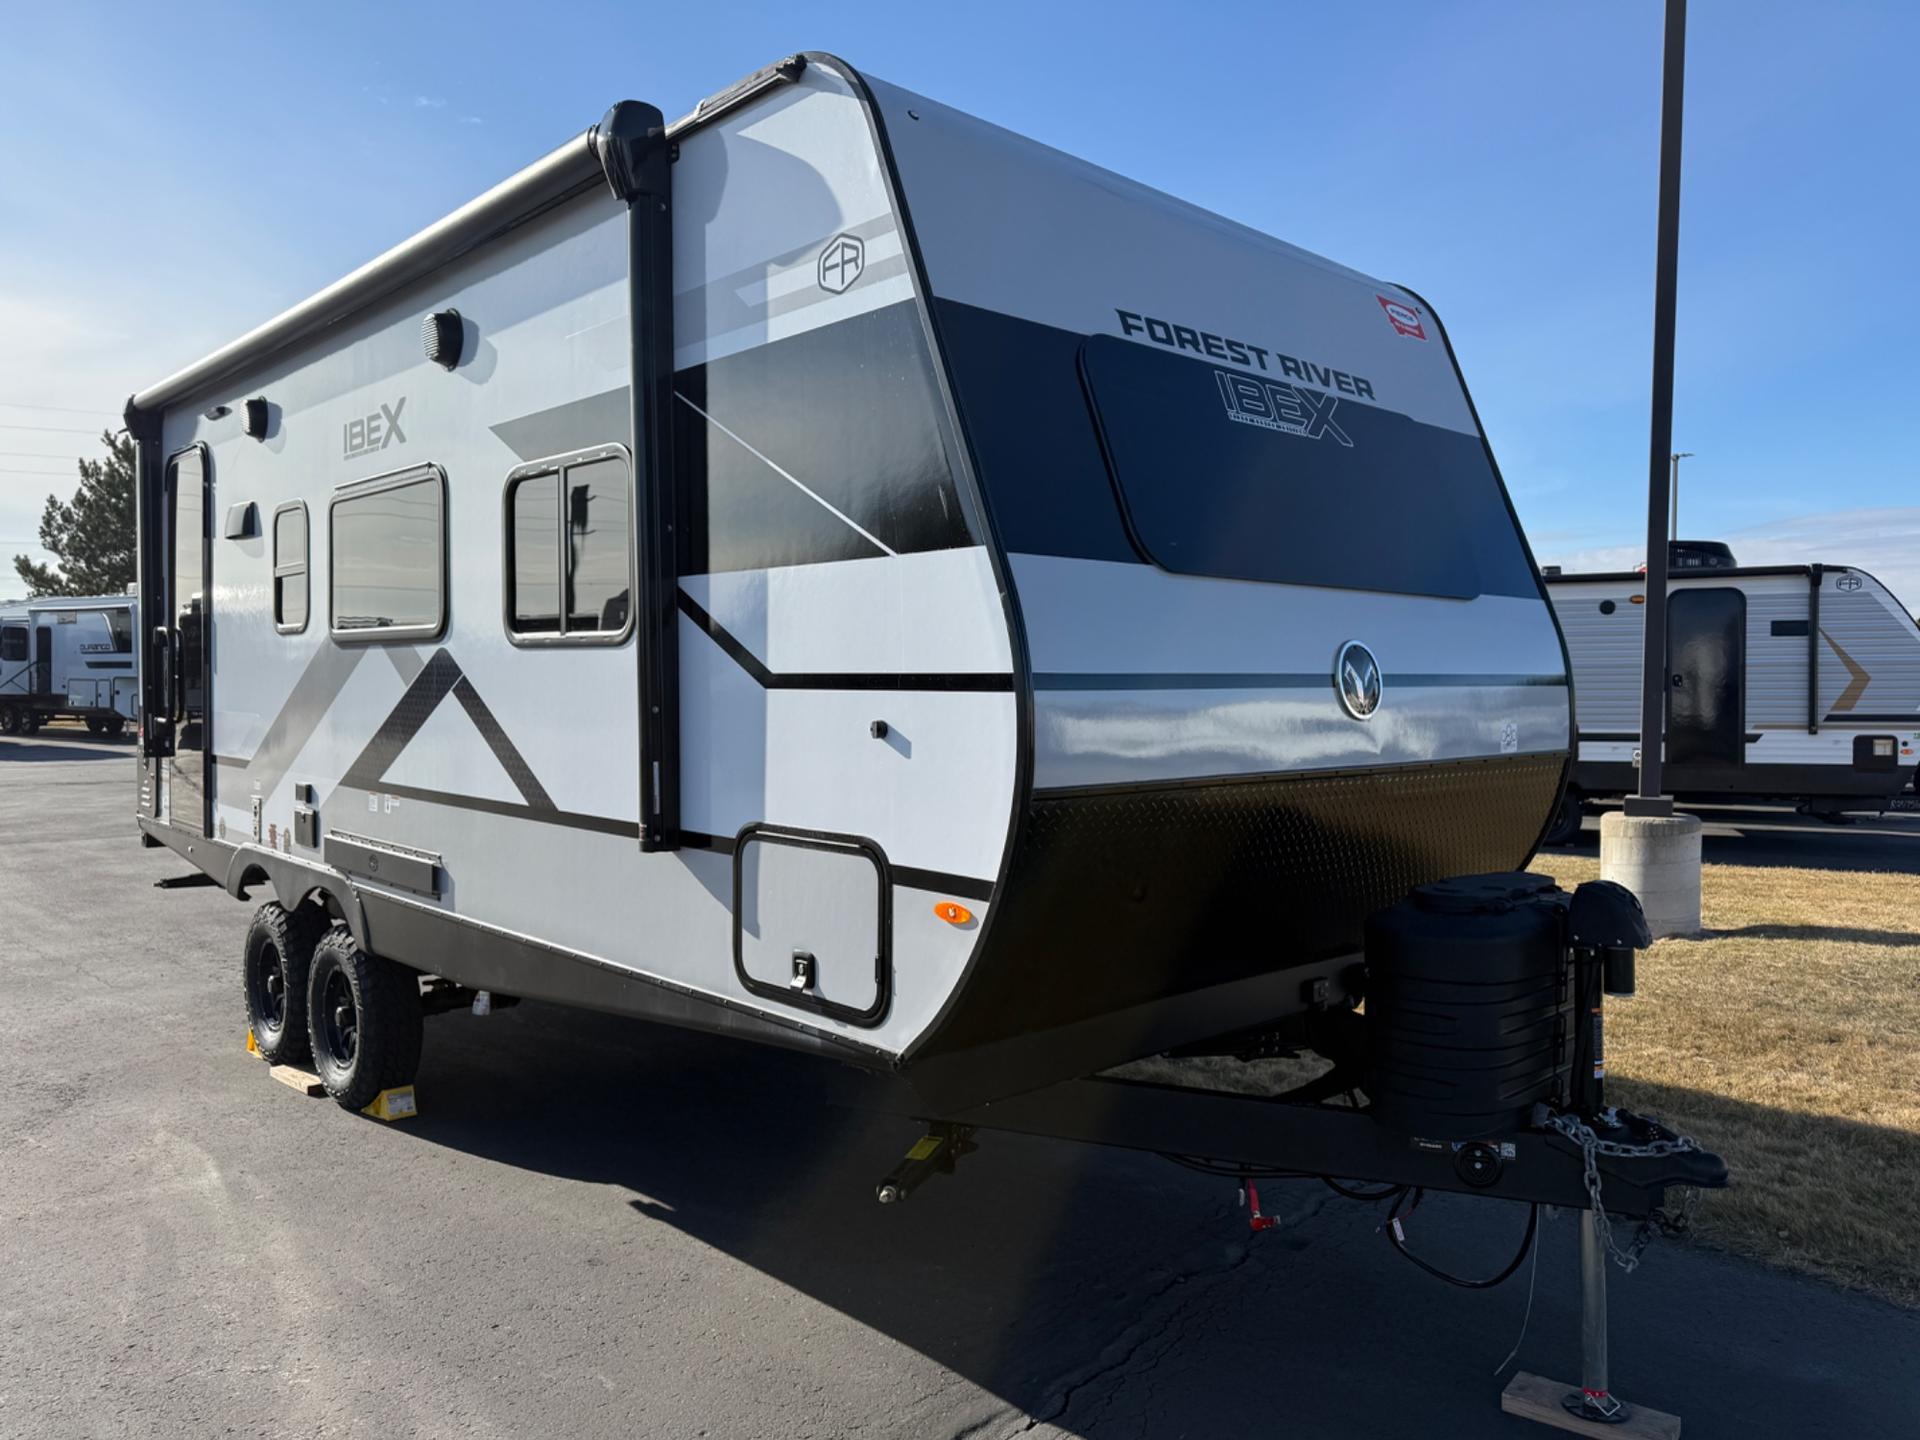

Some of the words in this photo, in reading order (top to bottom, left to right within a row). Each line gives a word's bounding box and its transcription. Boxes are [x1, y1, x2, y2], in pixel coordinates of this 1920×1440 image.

[821, 238, 863, 288] FR
[1114, 308, 1269, 370] FOREST
[1276, 353, 1376, 400] RIVER
[343, 396, 407, 455] IBEX
[1214, 370, 1354, 447] IBEX
